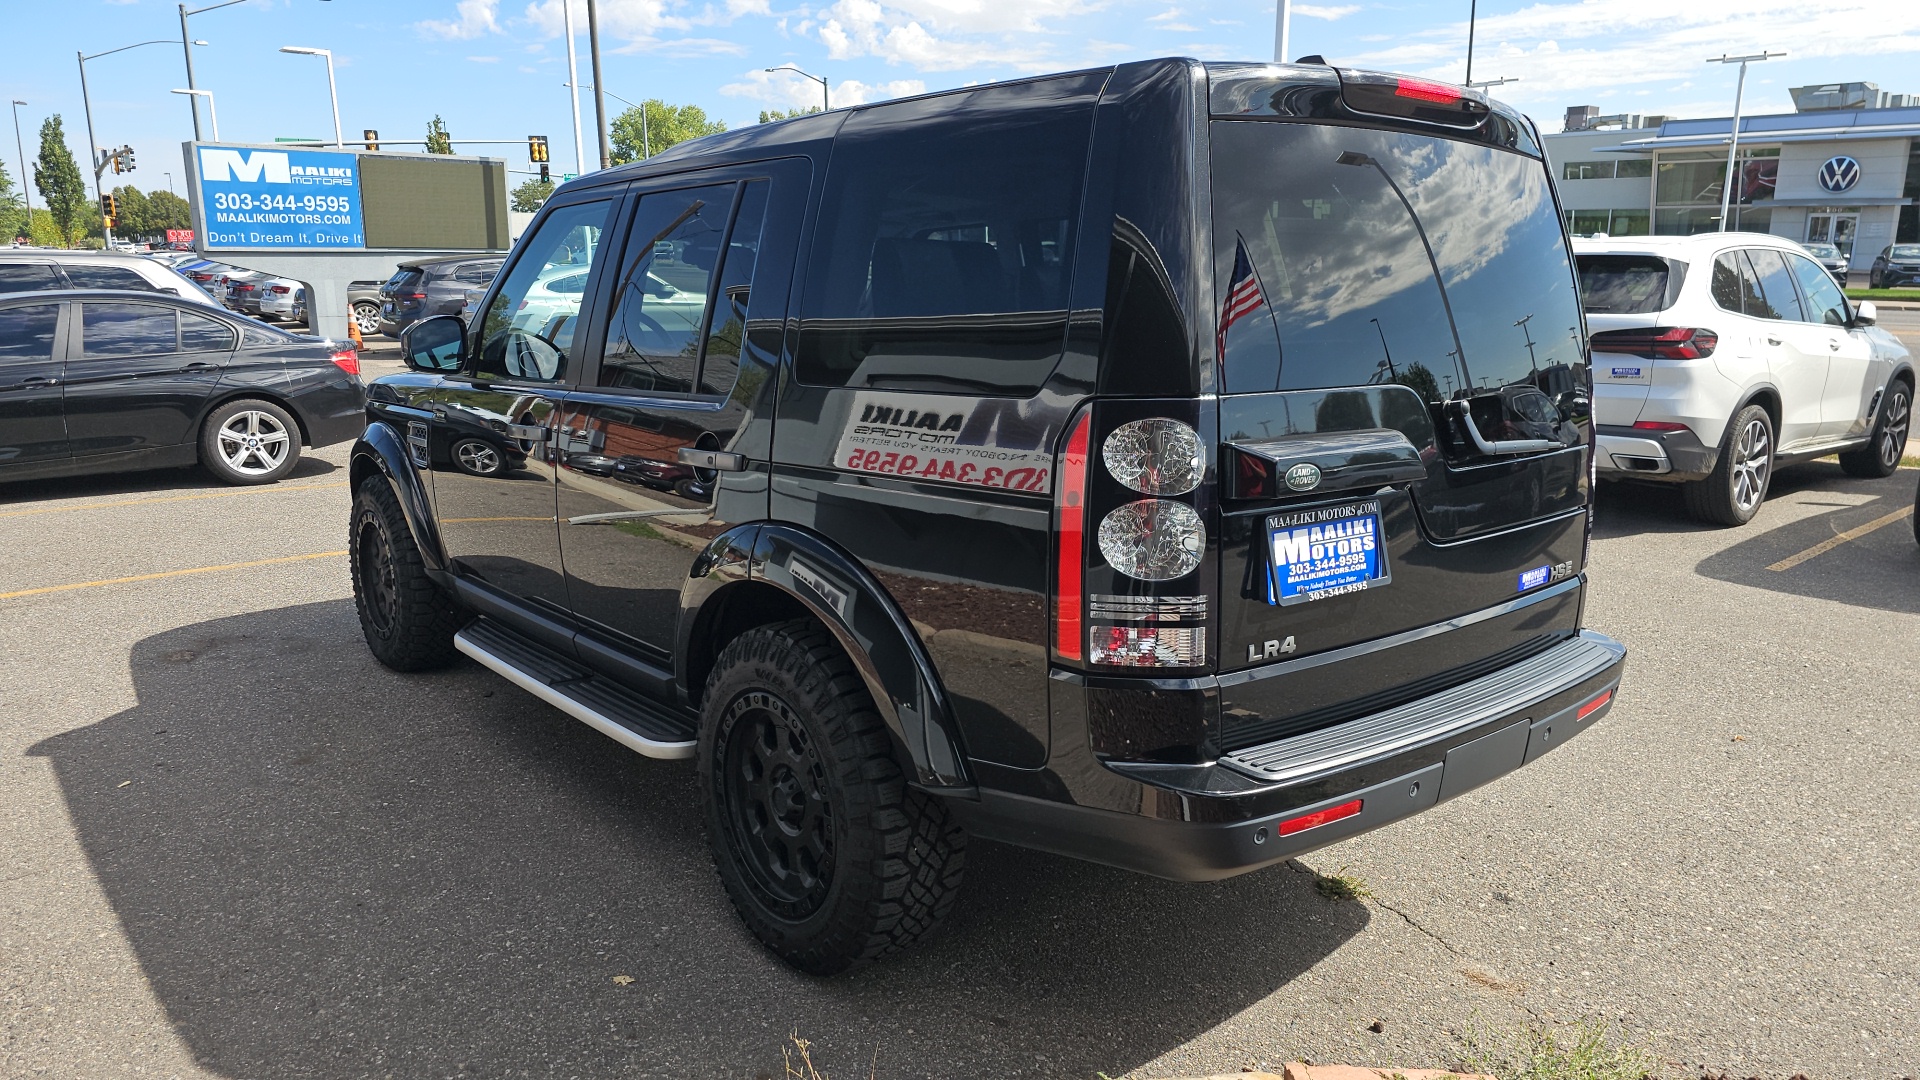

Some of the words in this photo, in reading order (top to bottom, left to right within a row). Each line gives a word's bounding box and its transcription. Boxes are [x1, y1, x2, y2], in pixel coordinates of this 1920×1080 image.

[291, 177, 353, 186] MOTORS
[214, 193, 350, 212] 303-344-9595
[216, 212, 351, 225] MAALIKIMOTORS.COM
[209, 231, 246, 243] Don't
[250, 232, 294, 243] Dream
[299, 233, 311, 245] It,
[316, 233, 349, 243] Drive
[354, 233, 362, 244] It
[1292, 468, 1311, 478] LAND
[1294, 475, 1316, 485] ROVER
[1317, 505, 1356, 522] MOTORS
[1287, 563, 1367, 583] MAALIKIMOTORS.COM
[1289, 553, 1366, 575] 303-344-9595
[1550, 560, 1573, 582] HSE
[1308, 581, 1368, 602] 303-344-9595
[1248, 635, 1297, 663] LR4
